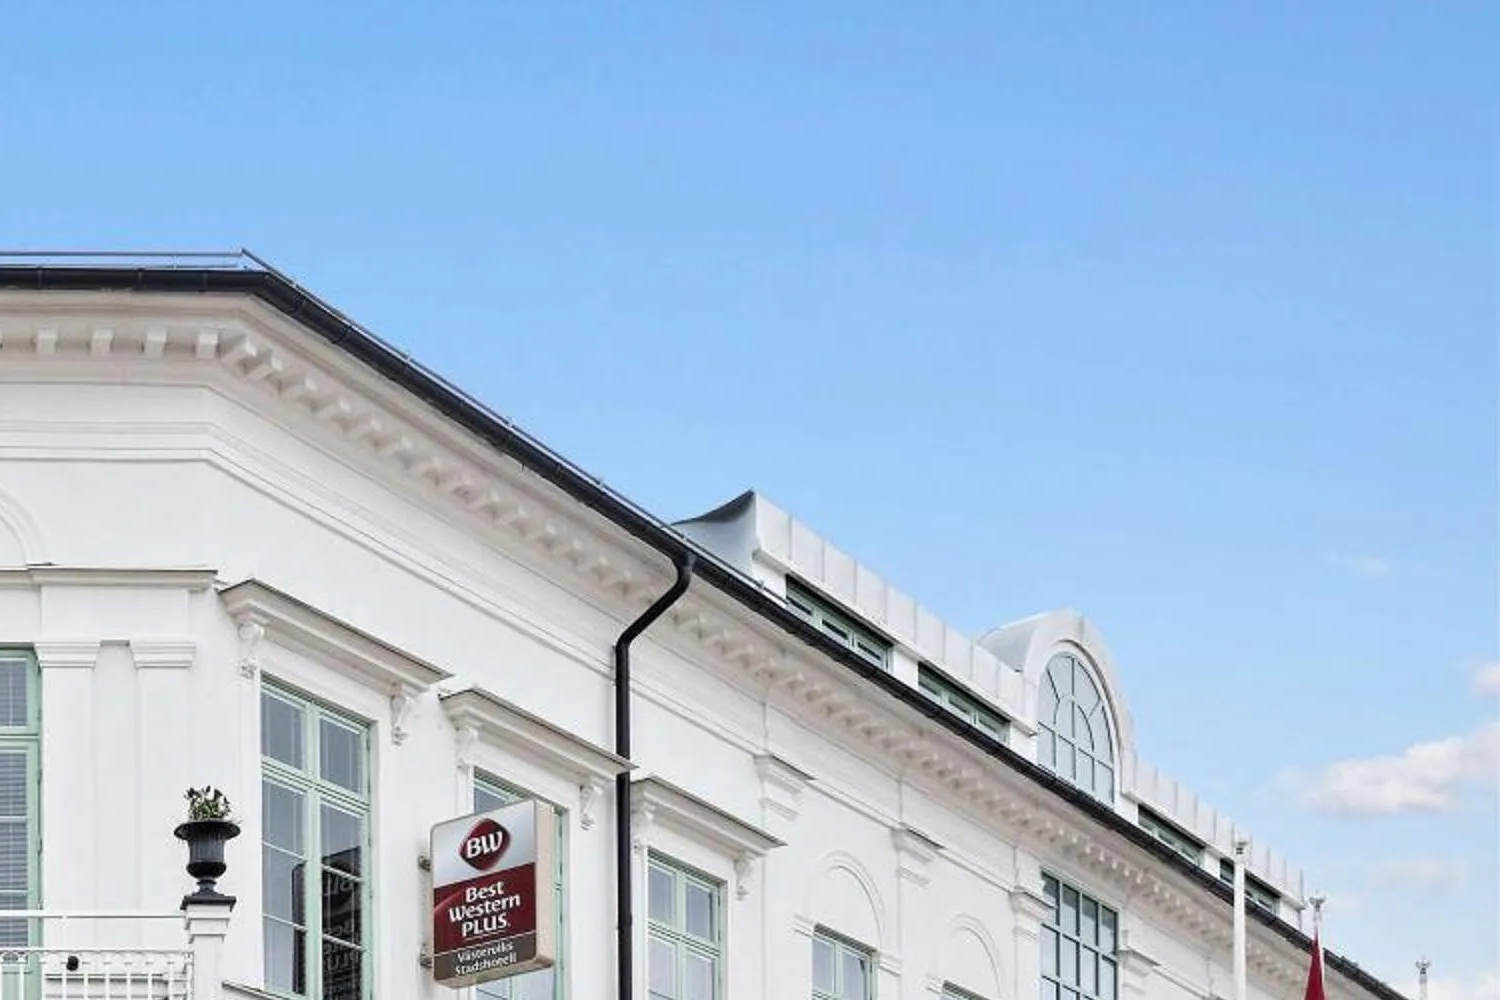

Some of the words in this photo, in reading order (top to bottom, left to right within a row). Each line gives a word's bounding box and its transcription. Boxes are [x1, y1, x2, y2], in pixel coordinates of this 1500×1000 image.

[466, 831, 503, 858] BW
[465, 881, 505, 902] Best
[448, 894, 520, 923] Western
[461, 913, 508, 937] PLUS
